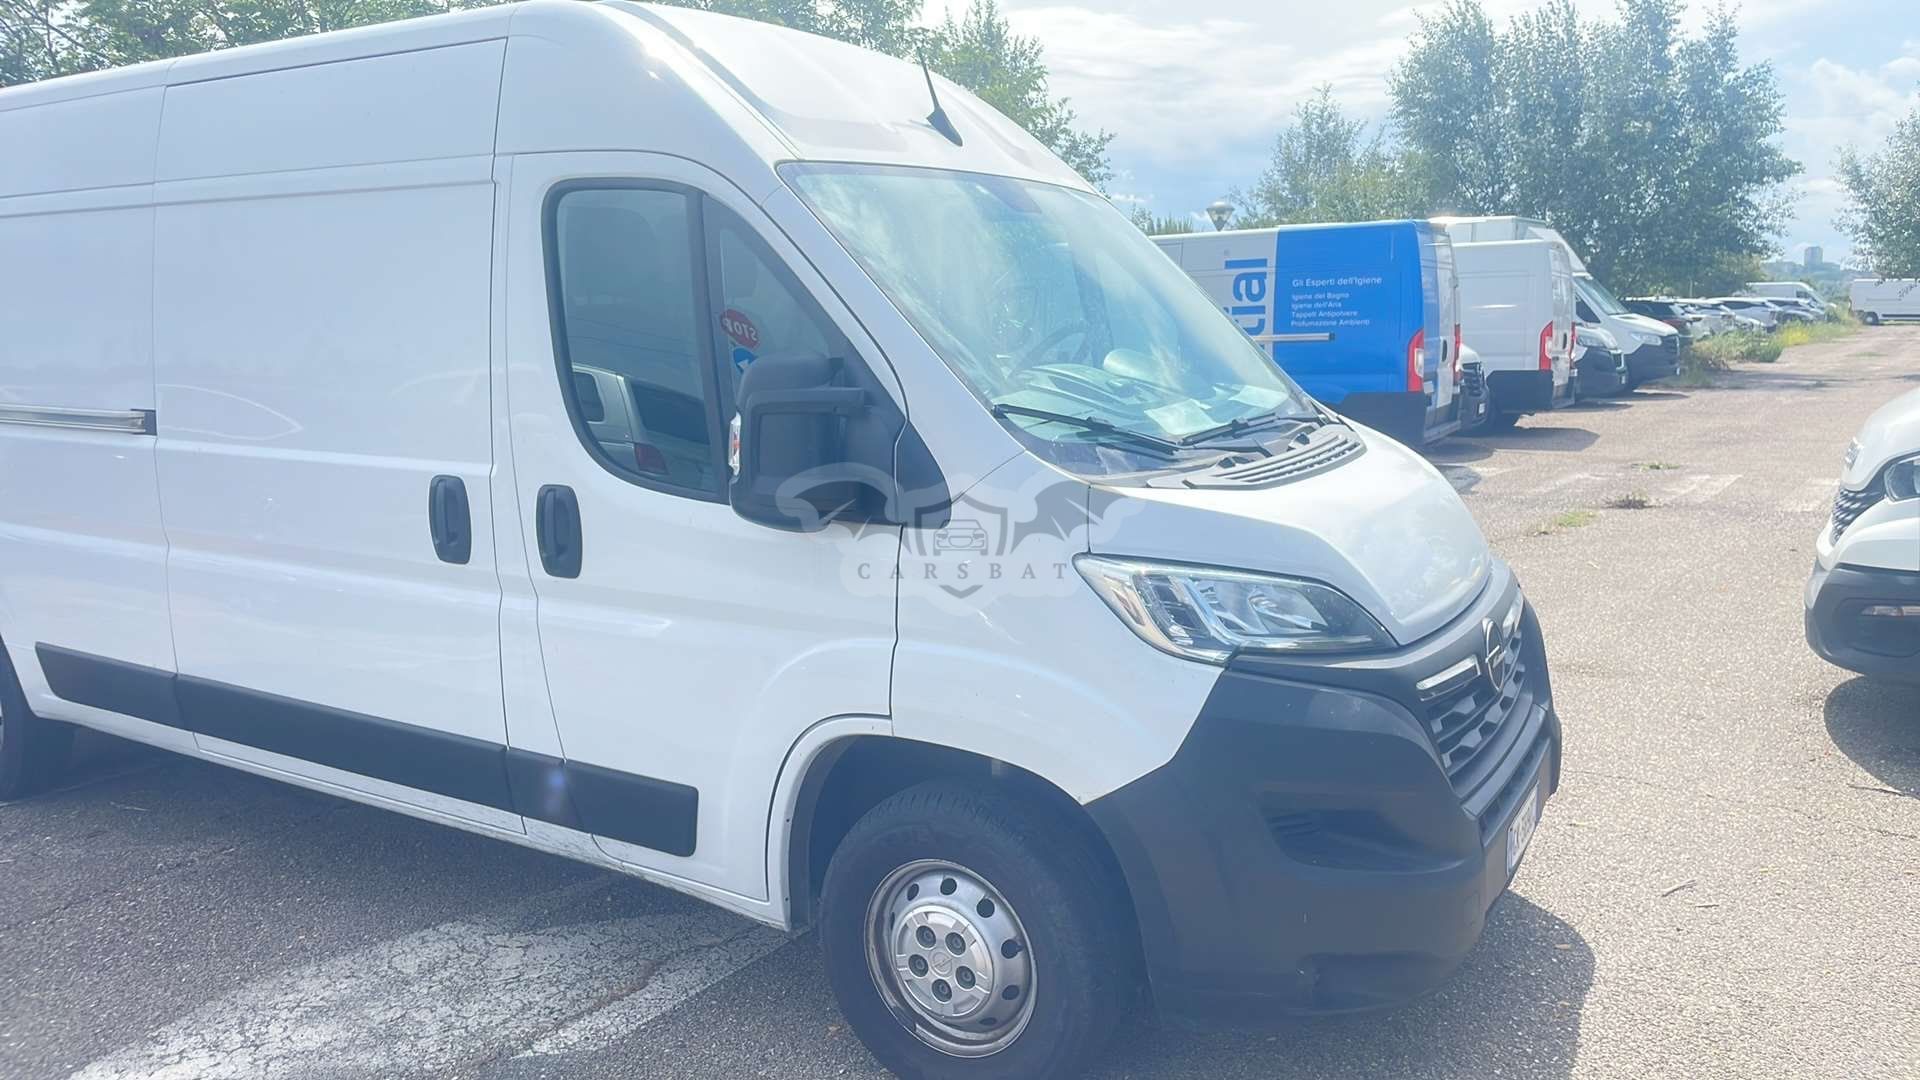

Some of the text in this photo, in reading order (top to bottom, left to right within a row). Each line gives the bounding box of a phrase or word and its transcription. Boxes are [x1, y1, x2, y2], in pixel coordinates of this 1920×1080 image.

[1292, 276, 1382, 288] Gli Esperti dell'Igiene
[1327, 292, 1350, 300] Bagno
[1225, 258, 1267, 350] tial
